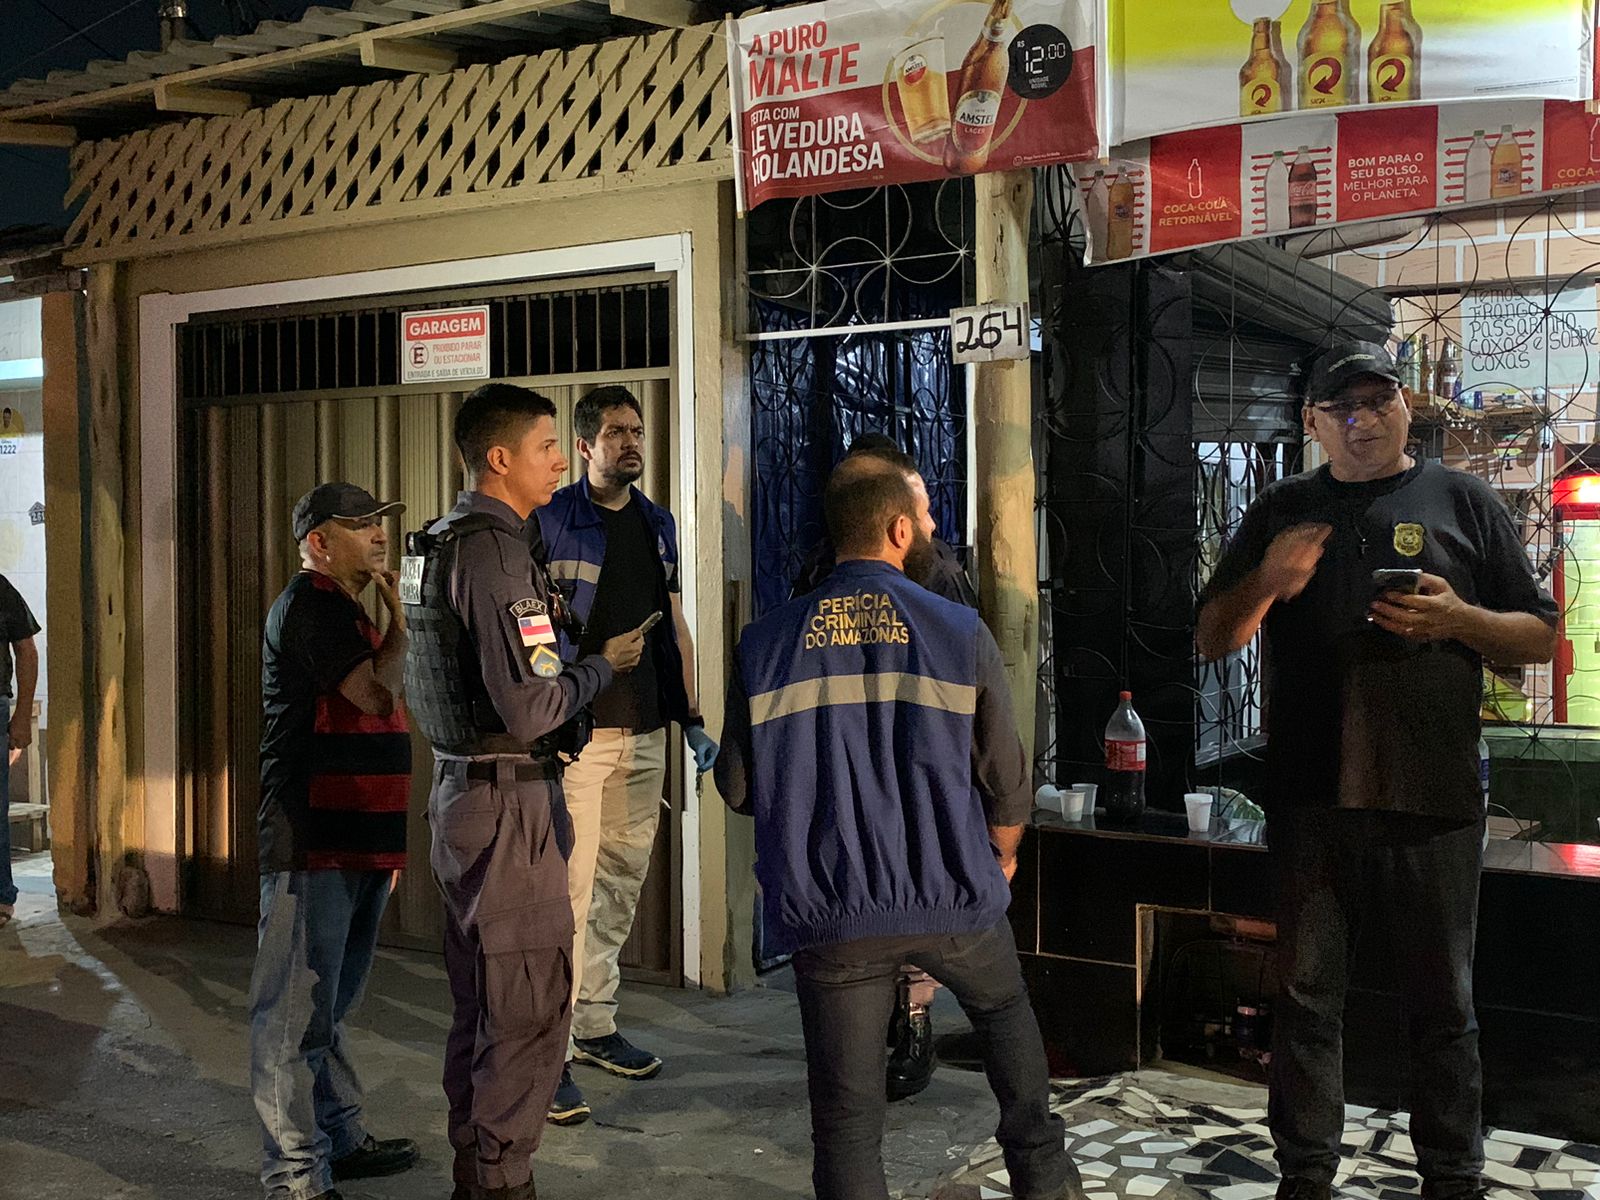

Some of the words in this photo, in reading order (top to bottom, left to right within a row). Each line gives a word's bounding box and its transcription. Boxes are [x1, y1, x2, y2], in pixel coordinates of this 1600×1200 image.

[748, 34, 763, 57] A
[768, 20, 827, 55] PURO
[749, 43, 860, 101] MALTE
[750, 109, 770, 127] FEITA
[773, 106, 799, 121] COM
[960, 112, 994, 125] AMSTEL
[751, 112, 865, 157] LEVEDURA
[964, 126, 986, 135] LAGER
[752, 142, 884, 187] HOLANDESA
[1348, 157, 1376, 168] BOM
[1379, 154, 1411, 165] PARA
[1414, 152, 1424, 161] O
[1350, 168, 1374, 179] SEU
[1377, 164, 1421, 177] BOLSO.
[1343, 179, 1393, 191] MELHOR
[1397, 176, 1429, 186] PARA
[1352, 193, 1361, 202] O
[1364, 188, 1420, 201] PLANETA.
[1159, 212, 1233, 226] RETORNÁVEL
[410, 317, 481, 335] GARAGEM
[956, 307, 1022, 353] 264
[432, 342, 459, 352] PROIBIDO
[461, 341, 482, 351] PARAR
[414, 347, 424, 364] E
[434, 355, 442, 364] OU
[444, 353, 481, 364] ESTACIONAR
[514, 600, 543, 614] BLAEX
[820, 588, 893, 614] PERÍCIA
[810, 610, 904, 631] CRIMINAL
[805, 632, 828, 649] DO
[831, 627, 909, 646] AMAZONAS
